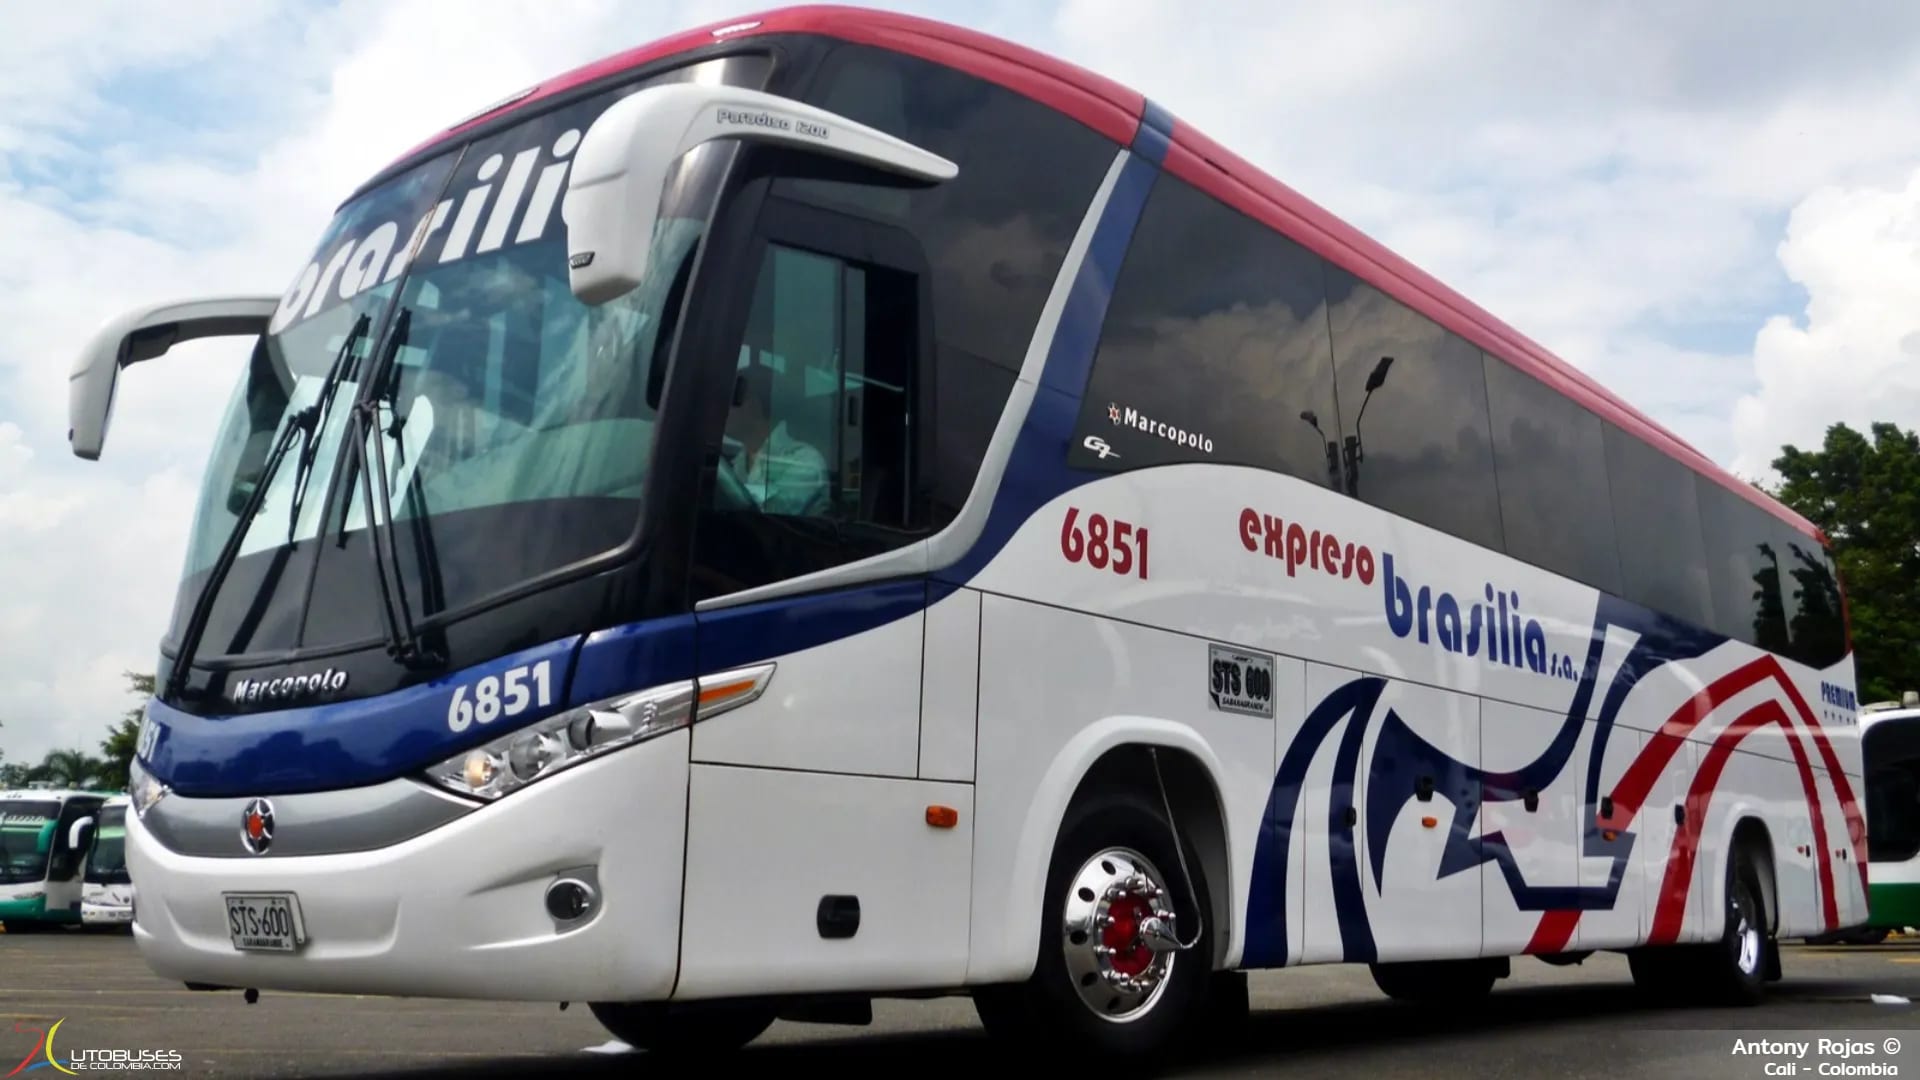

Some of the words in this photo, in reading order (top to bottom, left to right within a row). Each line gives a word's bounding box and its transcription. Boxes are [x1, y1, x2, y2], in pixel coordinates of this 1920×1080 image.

[716, 108, 791, 131] Paradiso
[268, 128, 581, 337] brasili
[1124, 407, 1213, 453] Marcopolo
[1061, 506, 1149, 581] 6851
[1239, 507, 1375, 586] expreso
[1382, 551, 1547, 675] brasilia
[233, 668, 348, 703] Marcopolo
[447, 659, 551, 733] 6851
[1212, 658, 1242, 697] STS
[1821, 680, 1856, 712] PREMIUM
